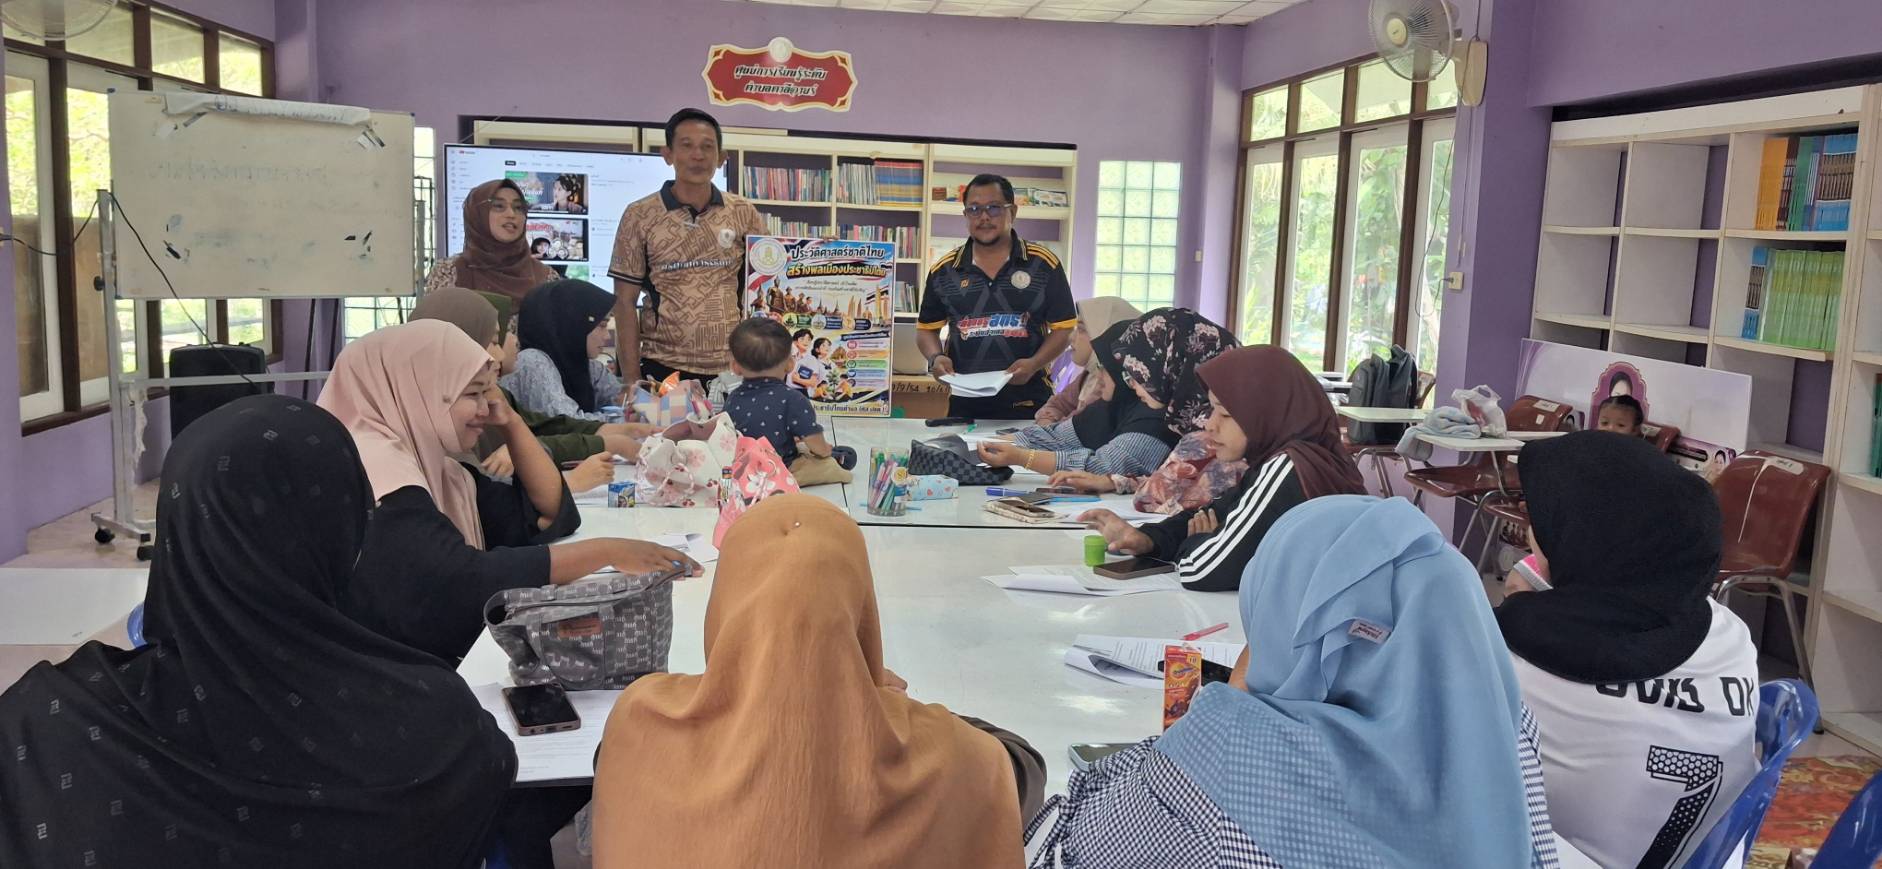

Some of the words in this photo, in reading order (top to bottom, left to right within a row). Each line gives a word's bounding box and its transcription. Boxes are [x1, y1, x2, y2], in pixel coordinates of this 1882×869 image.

[791, 245, 885, 259] ประวัติศาสตร์ชาติไทย
[787, 261, 886, 277] สร้างพลเมืองประชาธิปไตย
[1637, 745, 1723, 869] 7
